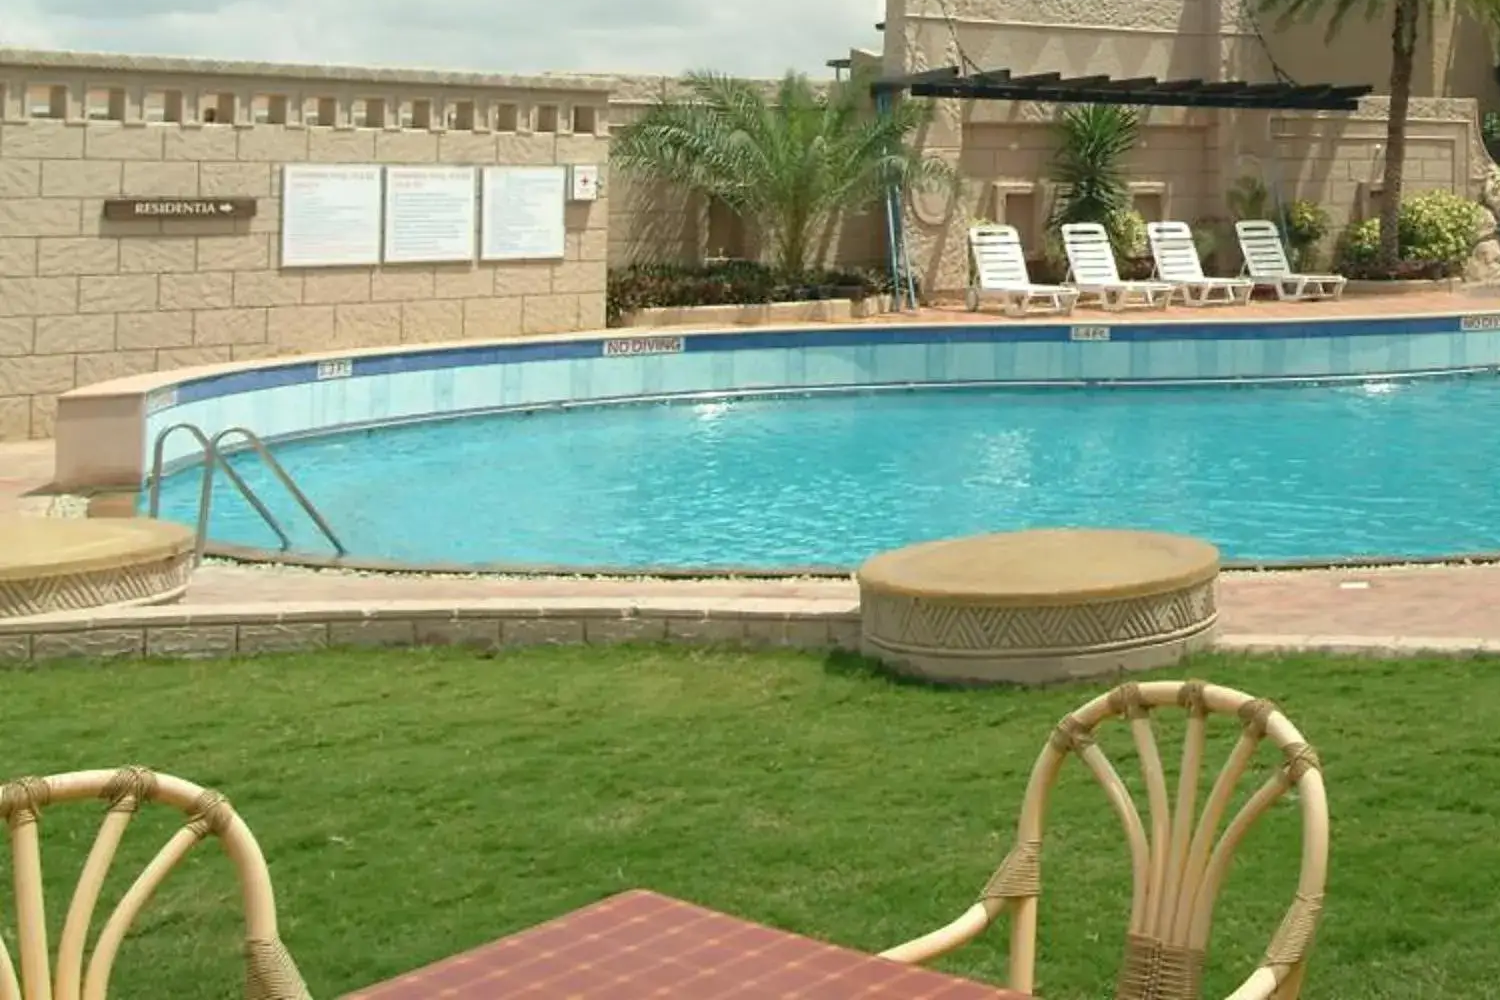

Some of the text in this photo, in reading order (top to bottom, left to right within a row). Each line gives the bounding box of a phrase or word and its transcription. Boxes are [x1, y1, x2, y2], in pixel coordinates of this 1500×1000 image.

[135, 202, 216, 214] RESIDENTIA
[607, 337, 680, 354] NO DIVING
